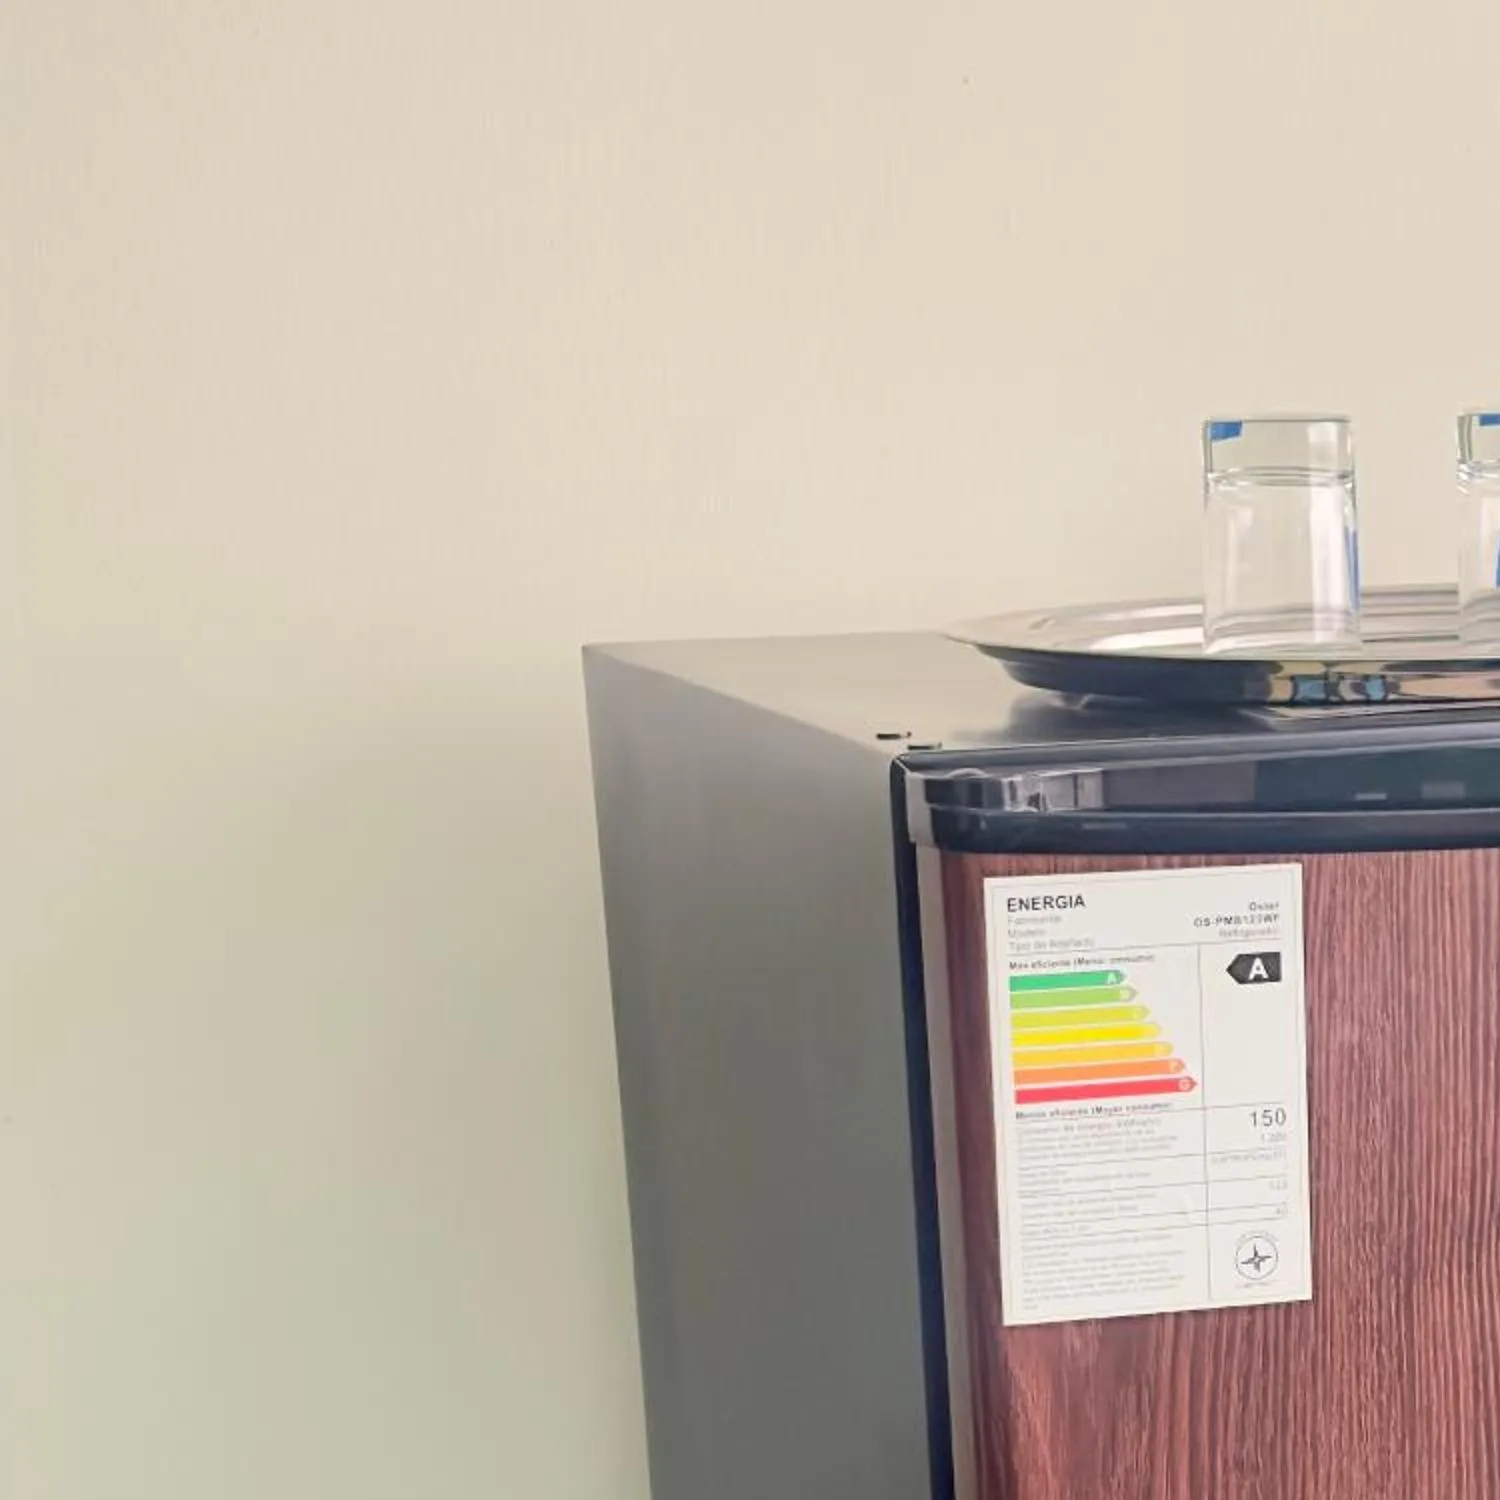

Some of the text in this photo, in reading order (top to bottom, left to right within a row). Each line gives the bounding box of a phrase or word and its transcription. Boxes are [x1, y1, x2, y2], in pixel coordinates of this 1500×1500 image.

[1007, 893, 1087, 912] ENERGIA
[1248, 957, 1269, 980] A
[1250, 1108, 1287, 1127] 150
